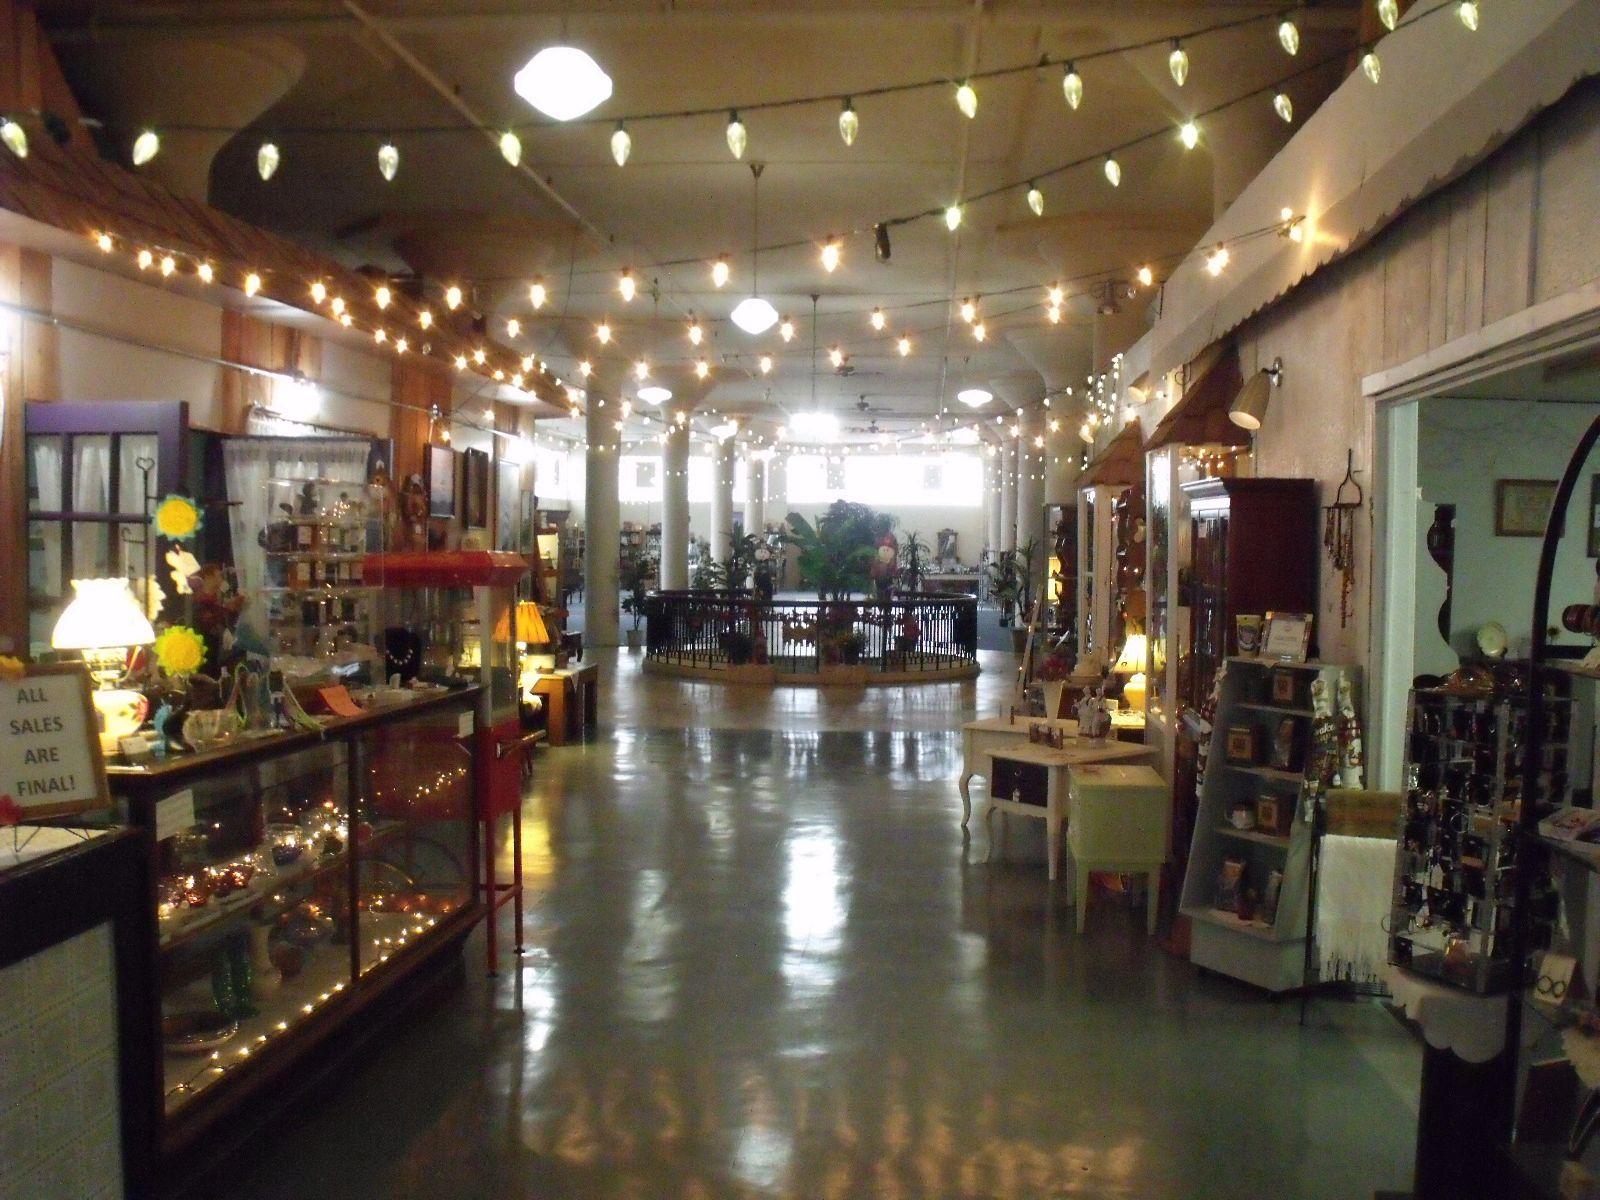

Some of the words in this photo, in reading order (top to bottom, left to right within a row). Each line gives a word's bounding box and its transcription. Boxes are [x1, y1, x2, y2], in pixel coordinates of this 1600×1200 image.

[17, 688, 48, 703] ALL
[9, 716, 63, 735] SALES
[24, 747, 60, 764] ARE
[16, 774, 75, 796] FINAL!
